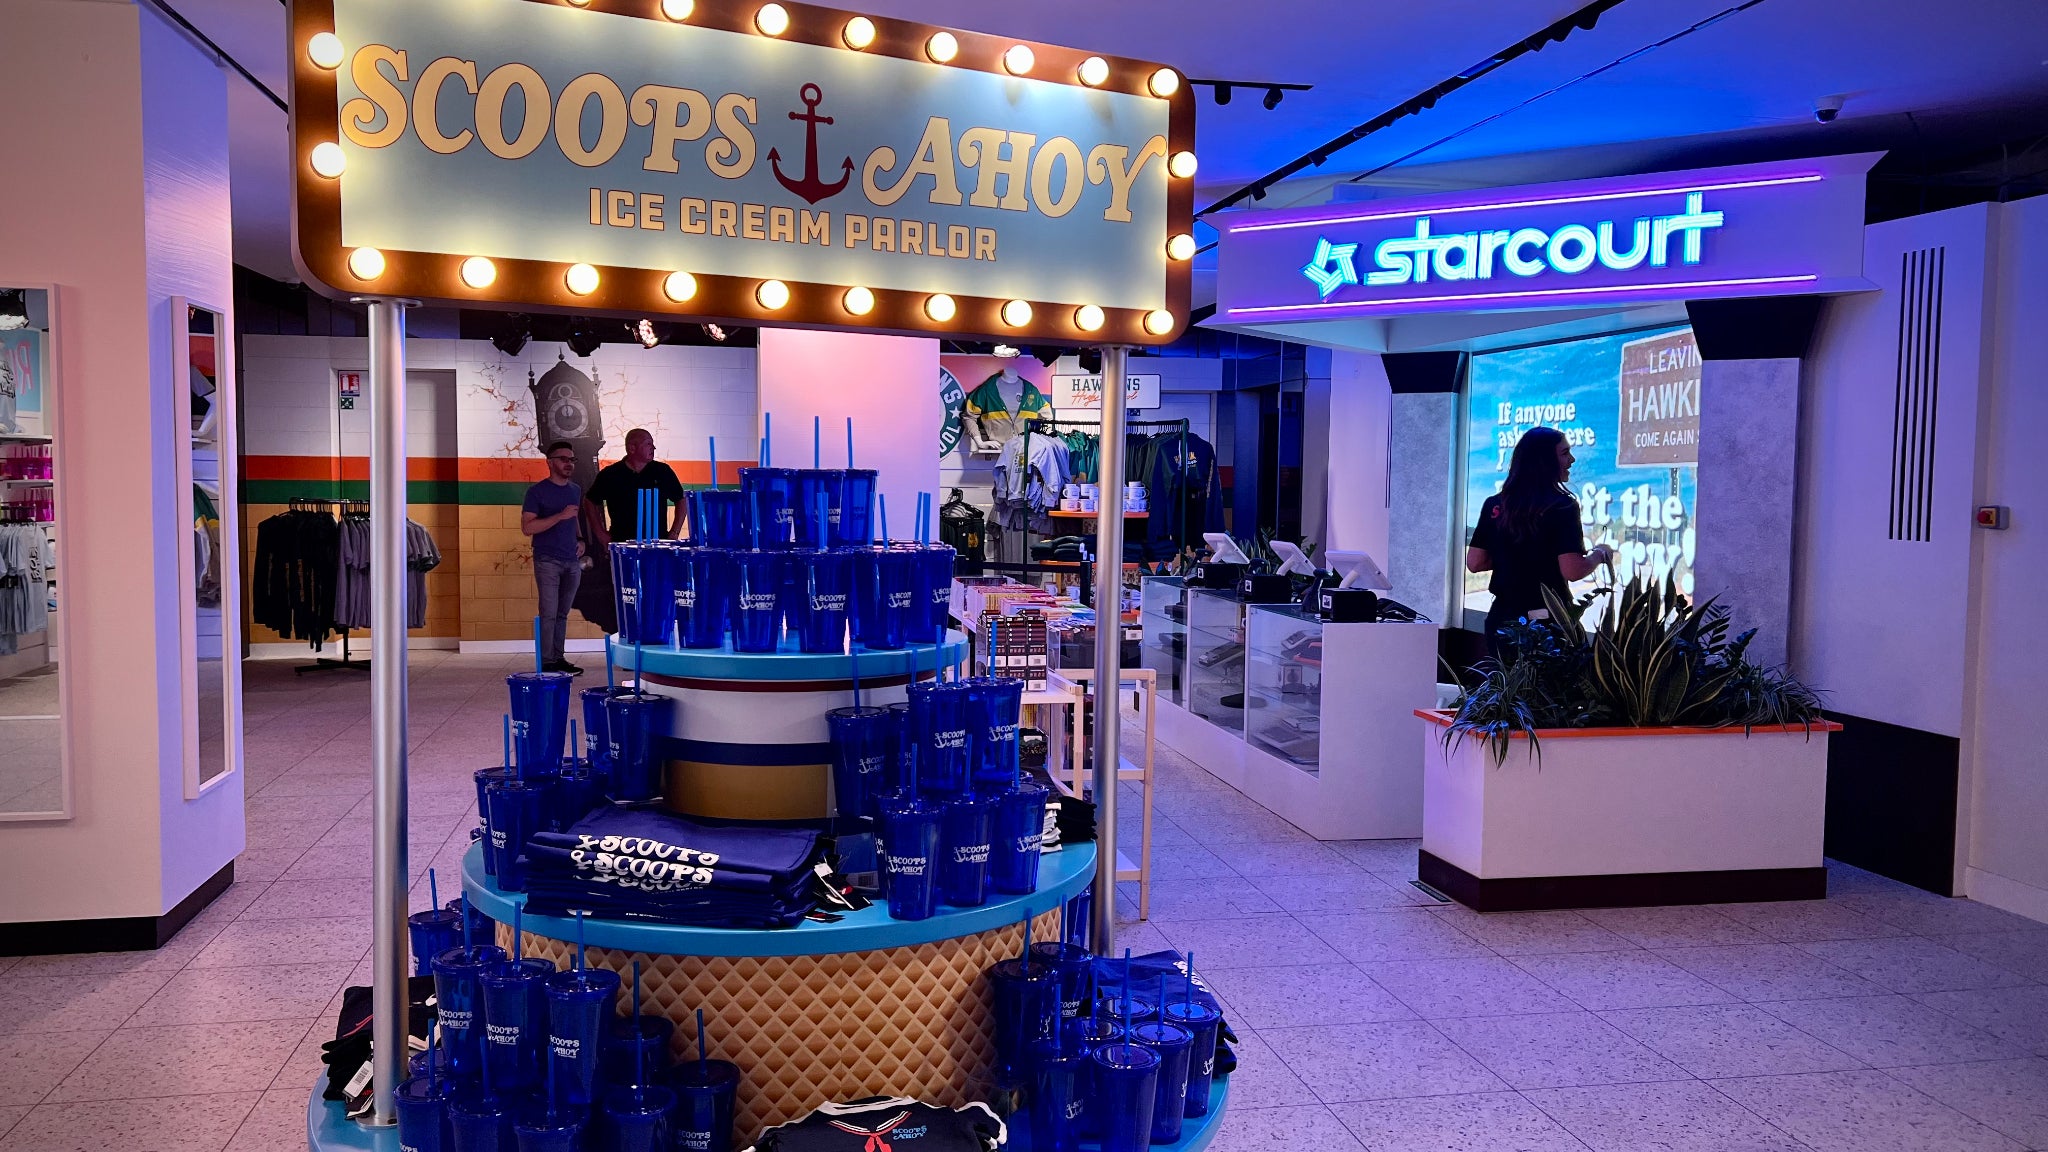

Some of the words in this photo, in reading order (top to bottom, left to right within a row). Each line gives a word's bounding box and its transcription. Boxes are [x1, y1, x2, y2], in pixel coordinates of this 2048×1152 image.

[340, 43, 758, 180] SCOOPS
[861, 115, 1168, 223] AHOY
[589, 187, 666, 231] ICE
[679, 197, 831, 246] CREAM
[844, 213, 997, 262] PARLOR
[1363, 190, 1725, 286] starcourt
[1649, 344, 1702, 374] LEAVIN
[1498, 401, 1512, 425] If
[1514, 402, 1576, 427] anyone
[1628, 379, 1701, 423] HAWKI
[1498, 425, 1526, 449] ask
[1635, 431, 1660, 448] COME
[1662, 429, 1695, 447] AGAIN
[1580, 482, 1612, 525] ft
[1620, 483, 1684, 530] the
[593, 852, 715, 884] SCOOPS
[892, 856, 927, 865] SCOOPS
[897, 865, 926, 873] AHOY
[892, 1125, 928, 1135] SCOOPS
[892, 1131, 926, 1140] AHOY
